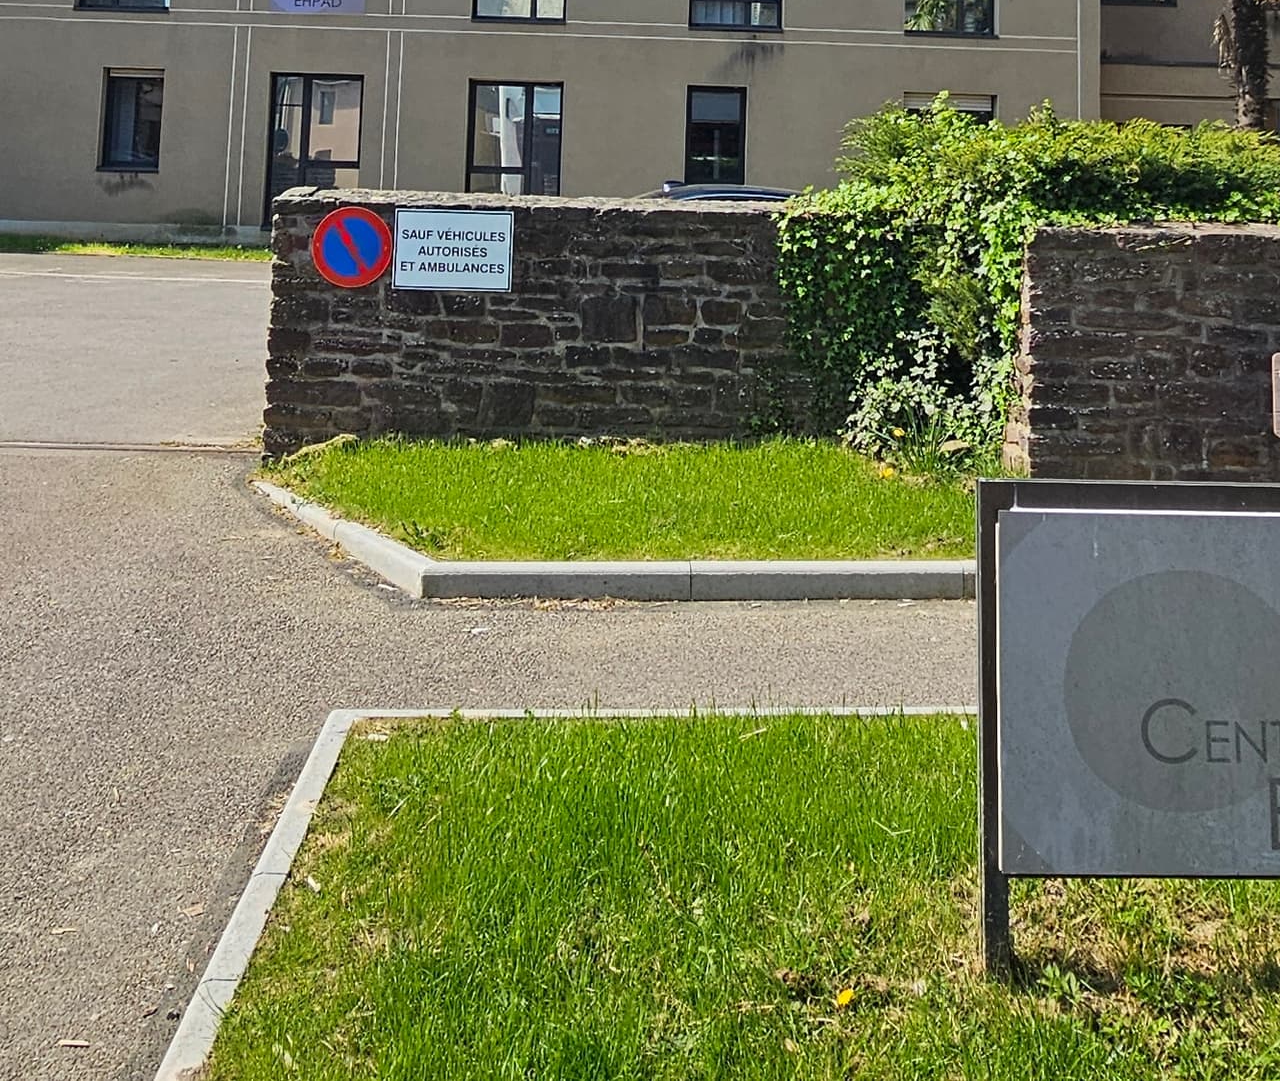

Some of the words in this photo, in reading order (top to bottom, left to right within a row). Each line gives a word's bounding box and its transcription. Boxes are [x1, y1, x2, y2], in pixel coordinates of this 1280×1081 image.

[402, 229, 433, 240] SAUF
[437, 228, 506, 242] VÉHICULES
[418, 244, 488, 257] AUTORISÉS
[400, 261, 415, 272] ET
[418, 262, 505, 274] AMBULANCES
